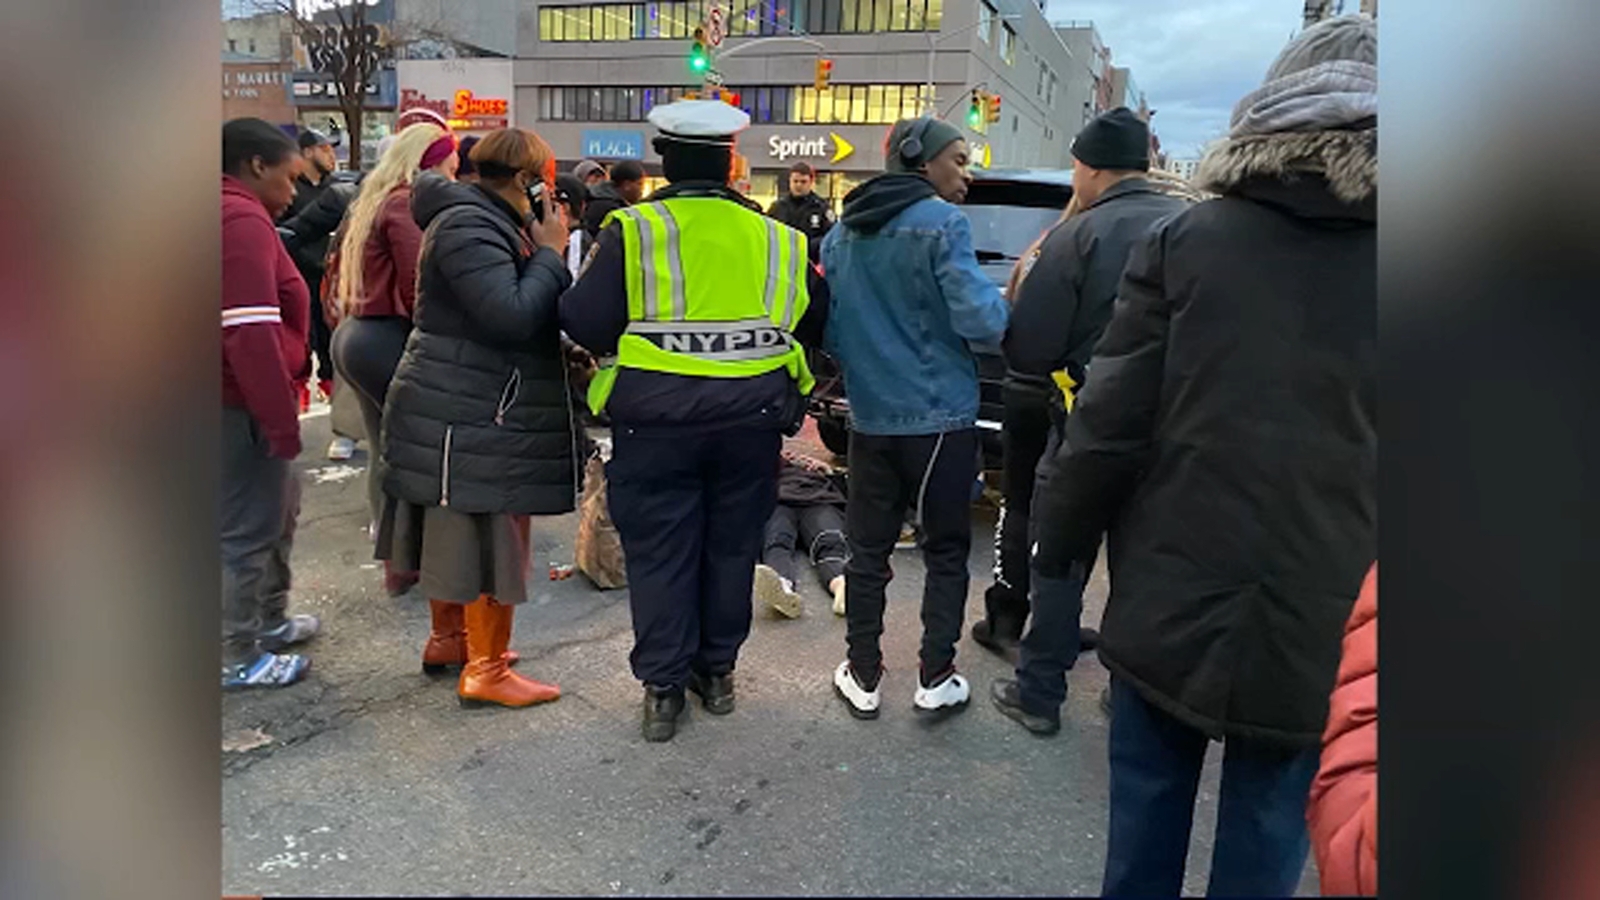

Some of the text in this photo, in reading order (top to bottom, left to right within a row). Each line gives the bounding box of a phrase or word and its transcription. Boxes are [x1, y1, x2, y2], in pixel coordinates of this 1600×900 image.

[454, 89, 507, 115] SHOES
[769, 134, 827, 160] Sprint
[662, 328, 779, 353] NYPD
